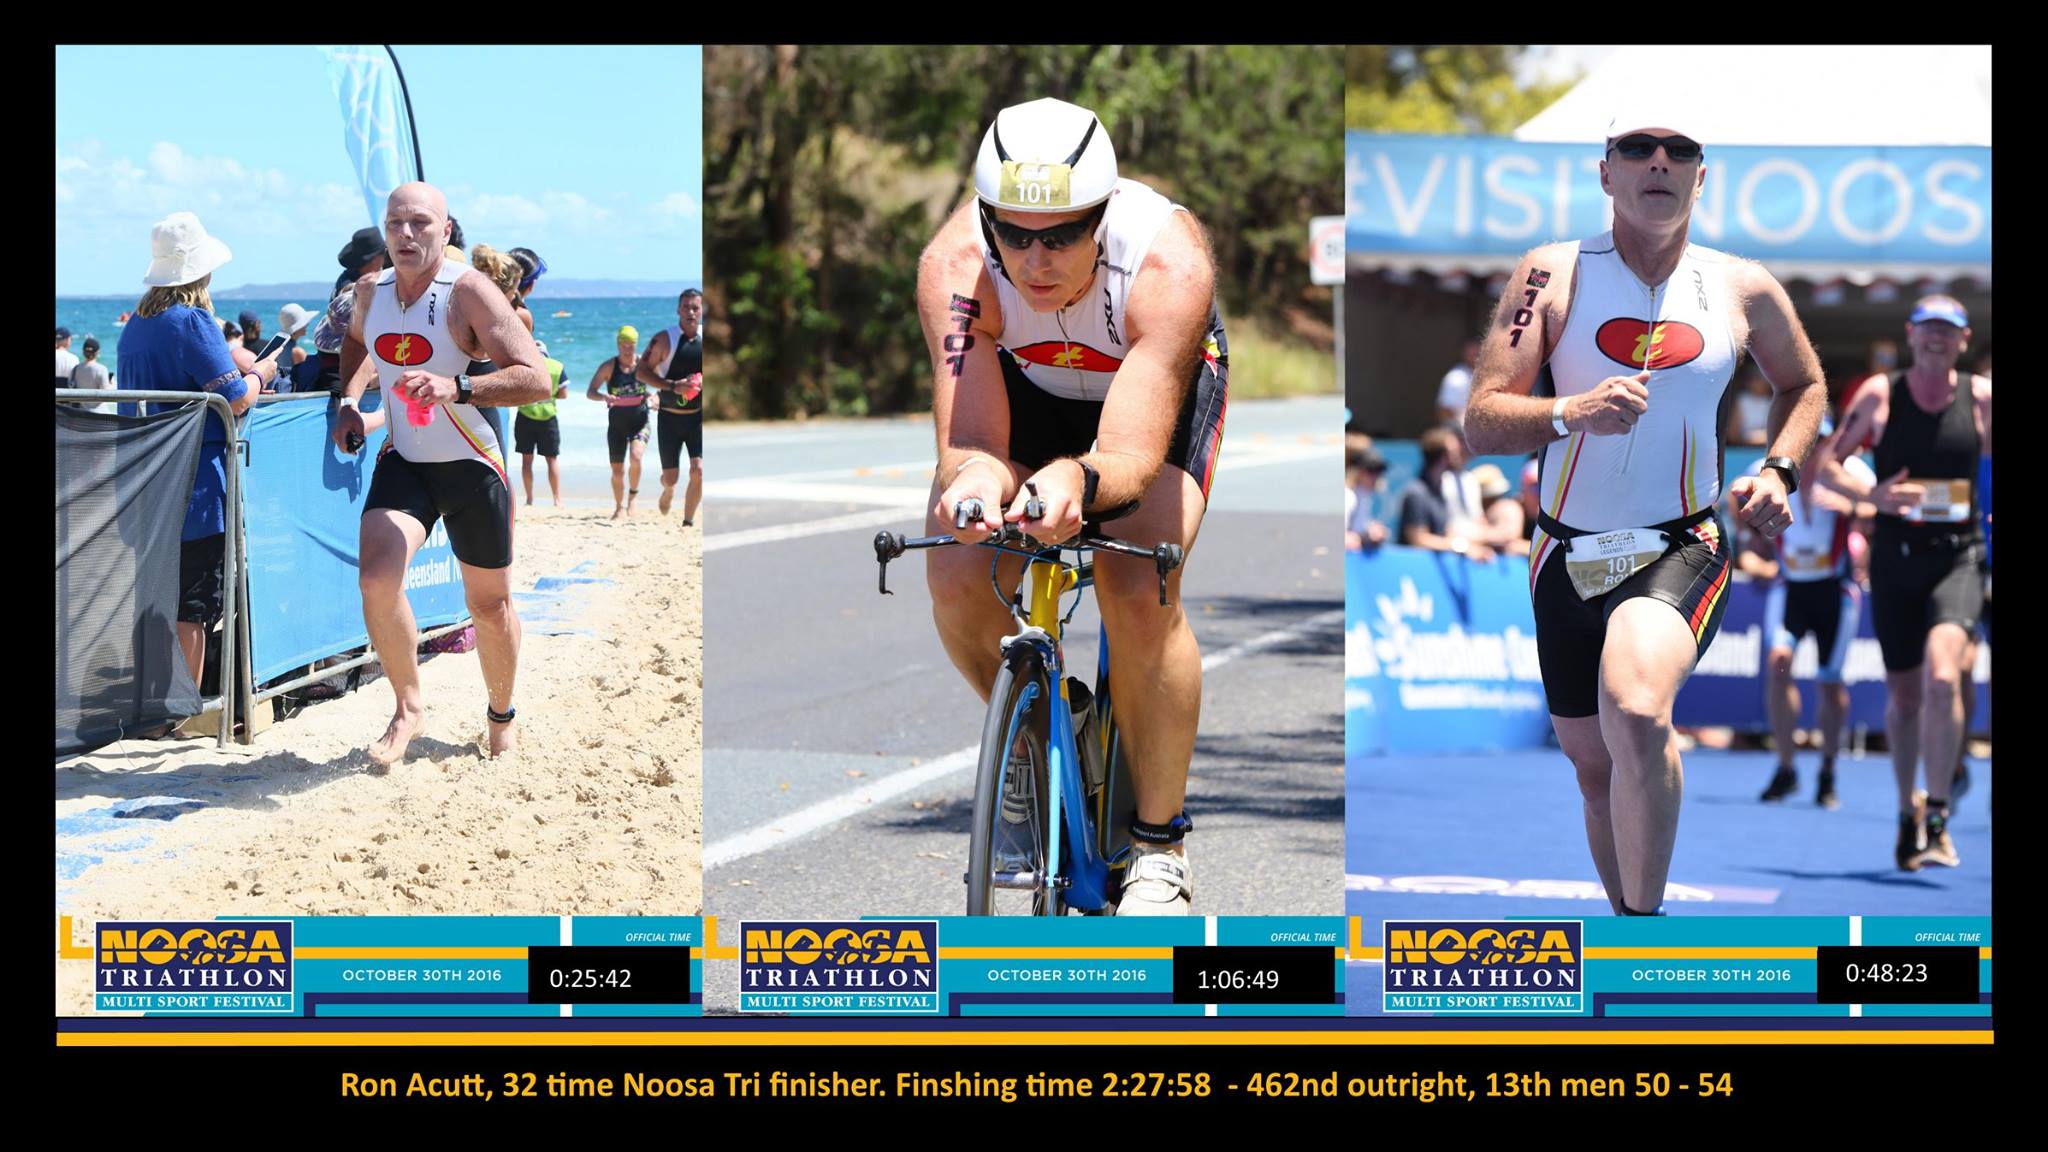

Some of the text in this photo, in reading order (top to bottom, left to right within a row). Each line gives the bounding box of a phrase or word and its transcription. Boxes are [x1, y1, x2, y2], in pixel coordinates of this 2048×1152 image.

[1016, 181, 1052, 204] 101
[1345, 152, 1602, 242] #VISI
[944, 314, 975, 377] 101
[1103, 287, 1122, 346] 2XU
[1509, 288, 1539, 348] 101
[404, 555, 450, 590] eensland
[1607, 555, 1636, 574] 101
